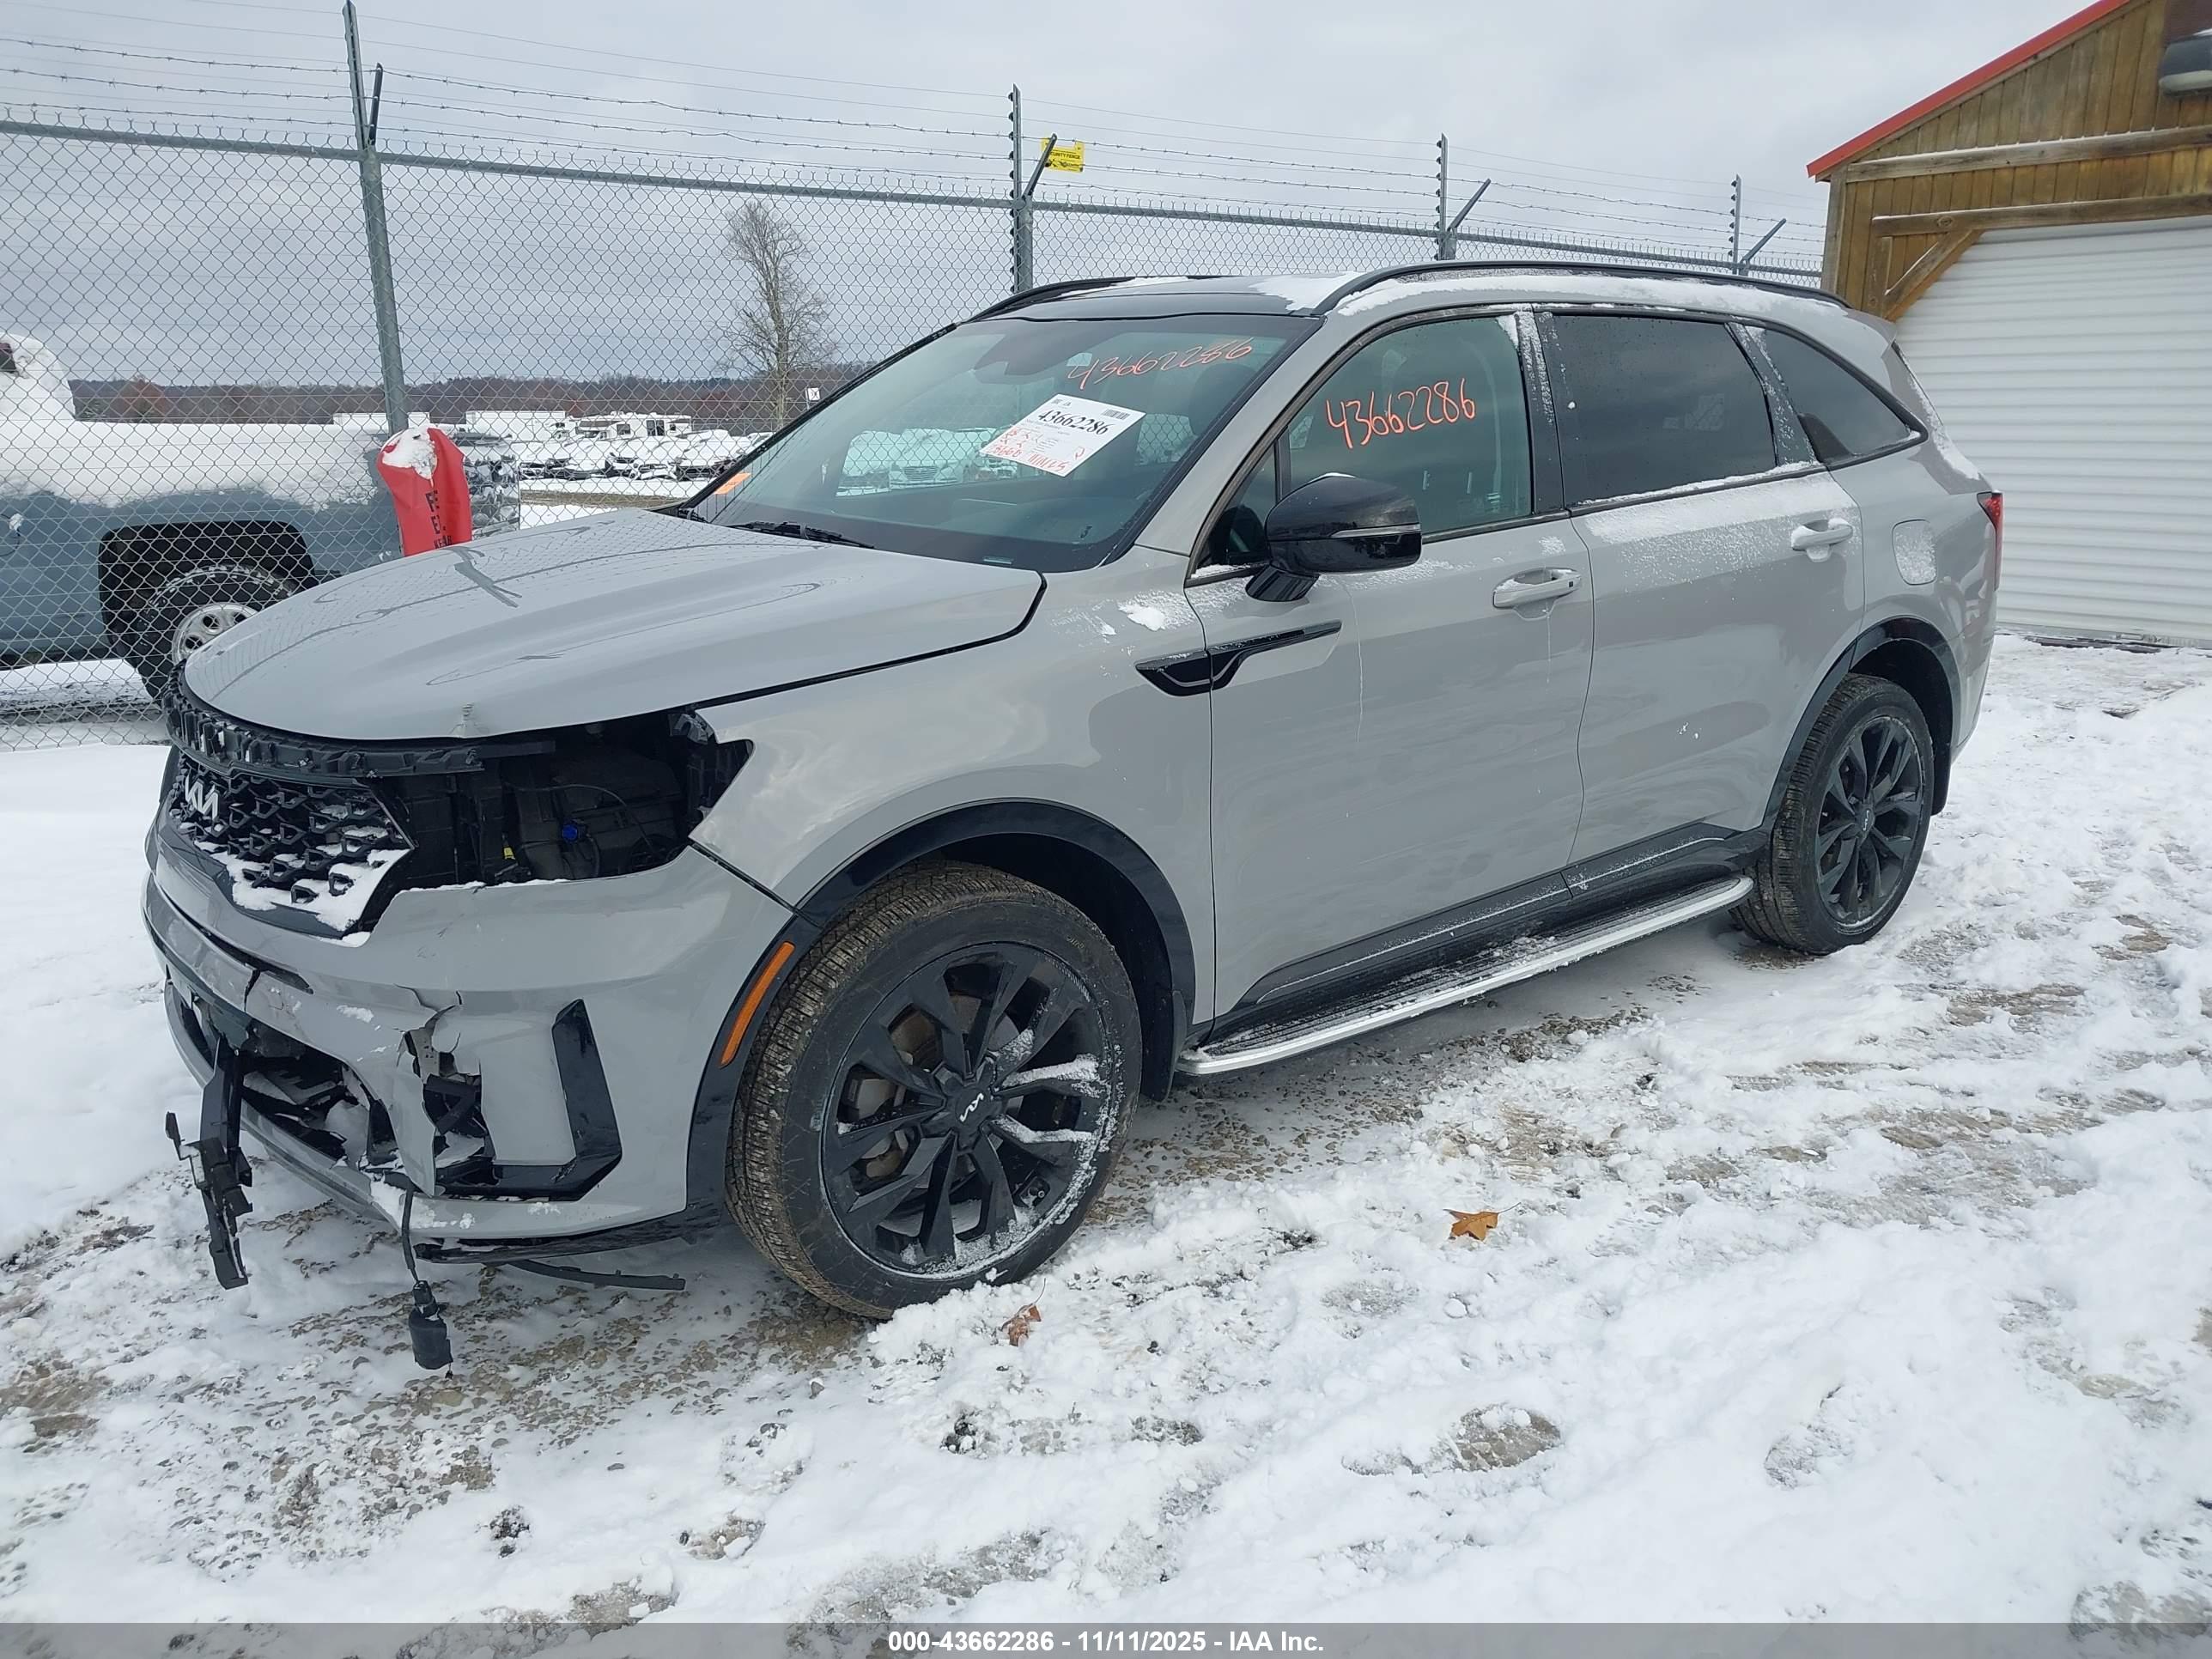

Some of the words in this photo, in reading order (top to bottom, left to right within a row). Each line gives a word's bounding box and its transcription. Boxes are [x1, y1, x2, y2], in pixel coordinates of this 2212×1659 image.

[1067, 337, 1255, 390] 43662286
[1037, 409, 1115, 435] 43662286
[1326, 377, 1475, 449] 43662286
